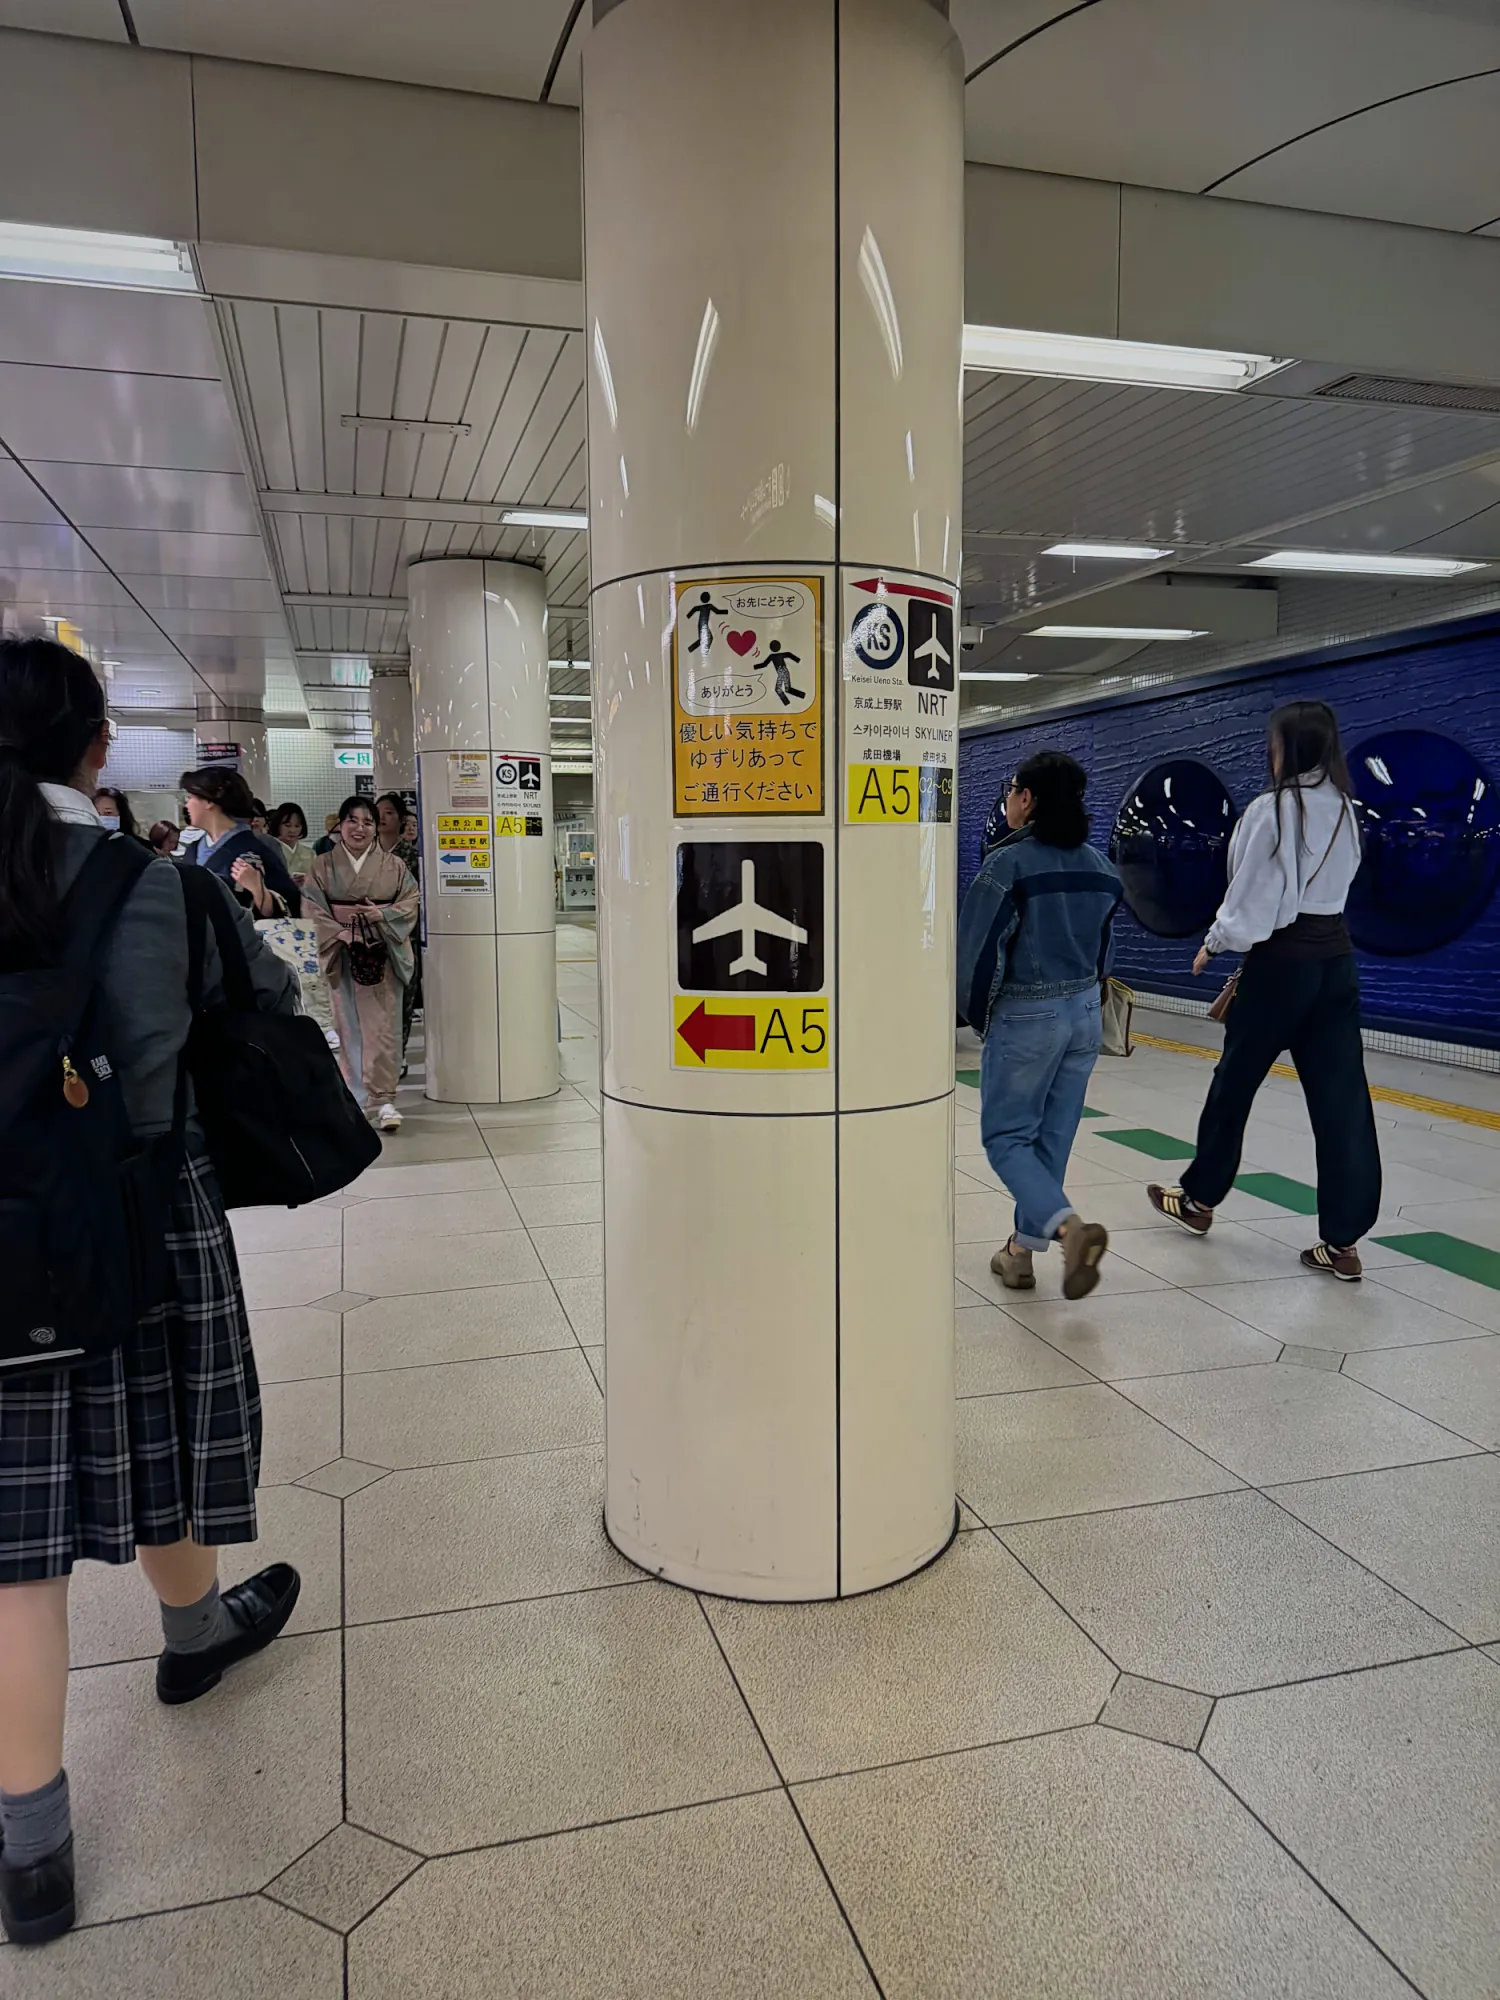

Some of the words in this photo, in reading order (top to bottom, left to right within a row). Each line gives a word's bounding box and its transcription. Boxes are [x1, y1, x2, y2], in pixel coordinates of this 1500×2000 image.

[736, 595, 795, 608] お先にどうぞ
[867, 622, 891, 651] KS
[852, 675, 872, 683] Keisei
[874, 677, 891, 685] Ueno
[892, 678, 904, 686] Sta.
[701, 685, 754, 698] ありがとう
[854, 697, 902, 711] 京成上野駅
[918, 692, 947, 716] NRT
[679, 720, 817, 743] 優しい気持ちで
[852, 724, 910, 738] 스카이라이너
[915, 726, 953, 742] SKYLINER
[690, 748, 805, 769] ゆずりあって
[863, 748, 901, 761] 成田機場
[501, 769, 512, 779] KS
[523, 791, 538, 800] NRT
[683, 781, 813, 803] ご通行ください
[858, 767, 910, 815] A5
[442, 819, 483, 827] 上野公園
[500, 817, 523, 834] A5
[759, 1008, 826, 1054] A5
